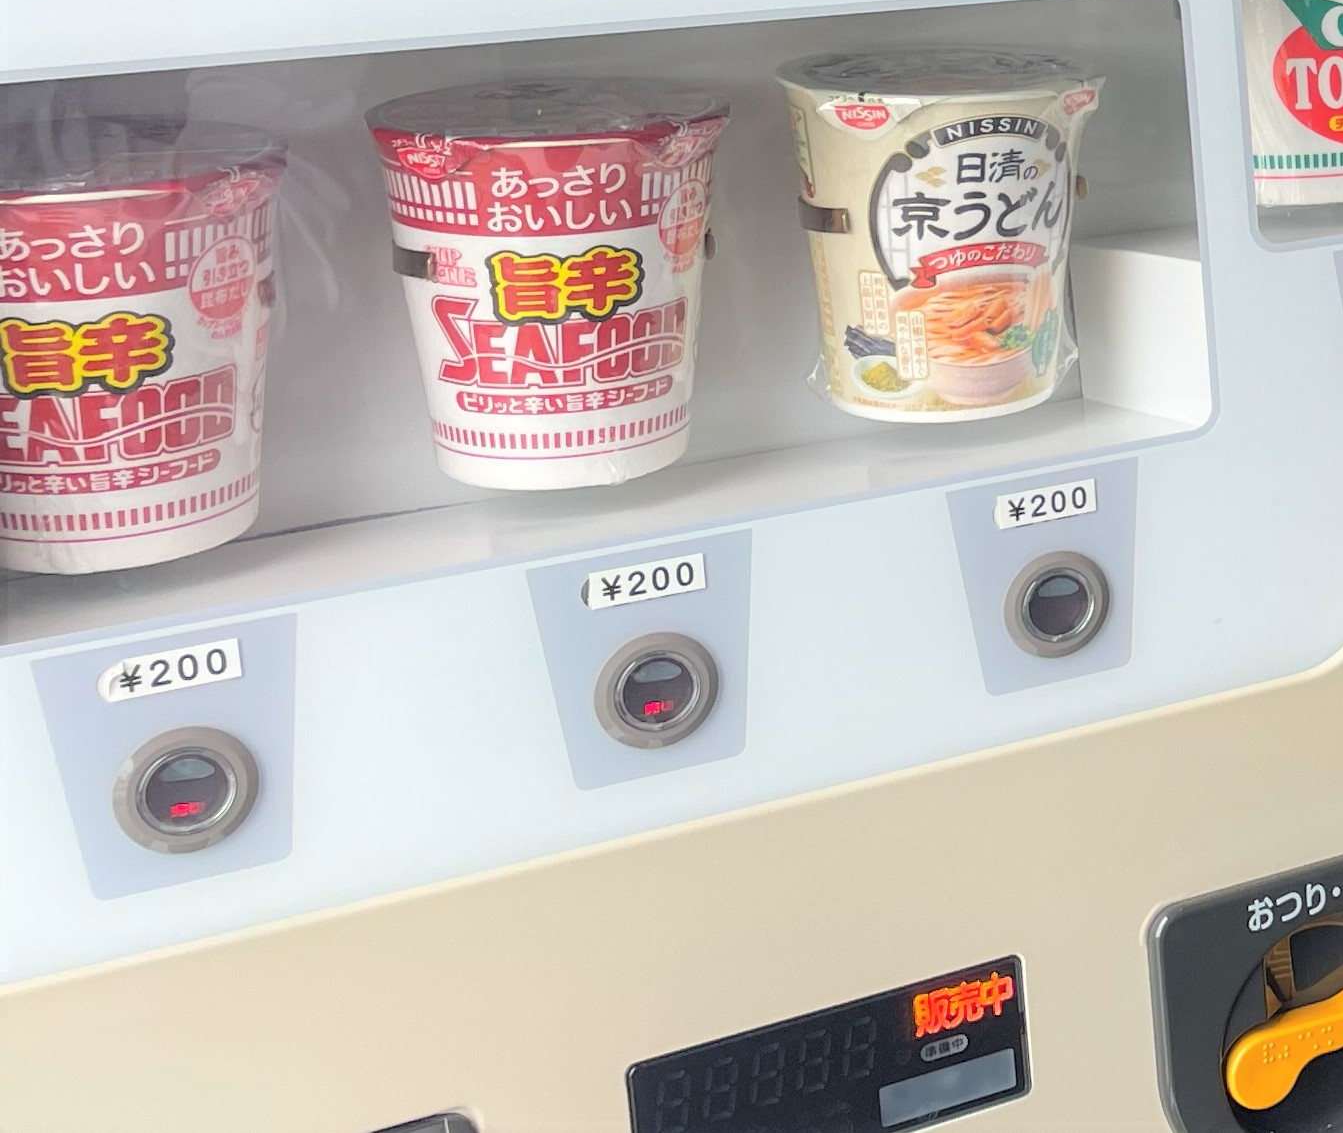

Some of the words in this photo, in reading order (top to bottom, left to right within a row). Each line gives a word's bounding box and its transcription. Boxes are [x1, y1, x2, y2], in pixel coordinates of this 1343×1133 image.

[841, 106, 887, 120] NISSIN
[946, 119, 1039, 141] NISSIN
[491, 164, 627, 199] あっさり
[956, 149, 1038, 184] 日清の
[487, 198, 632, 232] おいしい
[892, 181, 1063, 241] 京うどん
[928, 244, 1036, 270] つゆのこだわり
[498, 250, 636, 316] 旨辛
[4, 317, 166, 391] 旨辛
[431, 297, 689, 388] SEAFOOD
[1007, 485, 1089, 522] ¥200
[601, 561, 696, 602] ¥200
[119, 647, 228, 694] ¥200
[912, 971, 1015, 1038] 販売中
